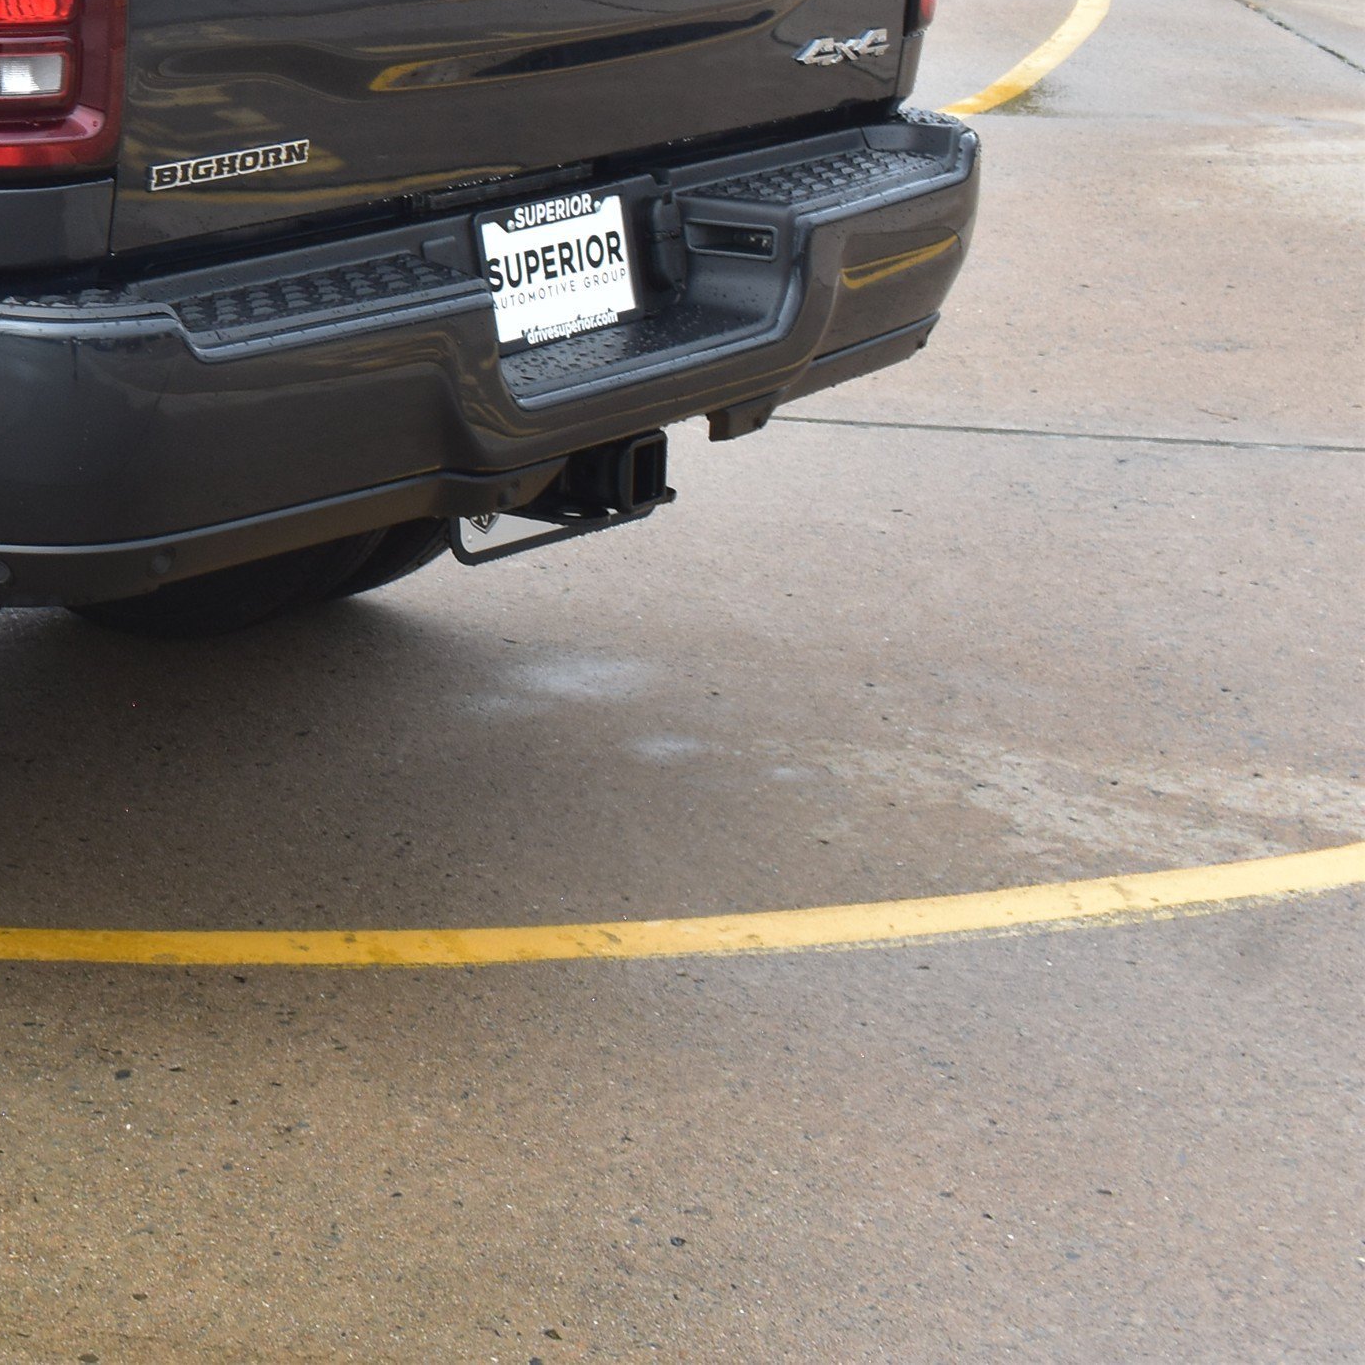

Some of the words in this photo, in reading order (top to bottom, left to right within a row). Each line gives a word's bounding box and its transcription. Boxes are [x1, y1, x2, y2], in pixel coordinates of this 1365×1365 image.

[150, 138, 310, 191] BIGHORN
[514, 193, 593, 229] SUPERIOR
[486, 231, 624, 293] SUPERIOR
[583, 266, 626, 288] GROUP
[526, 311, 618, 345] drivesuperior.com
